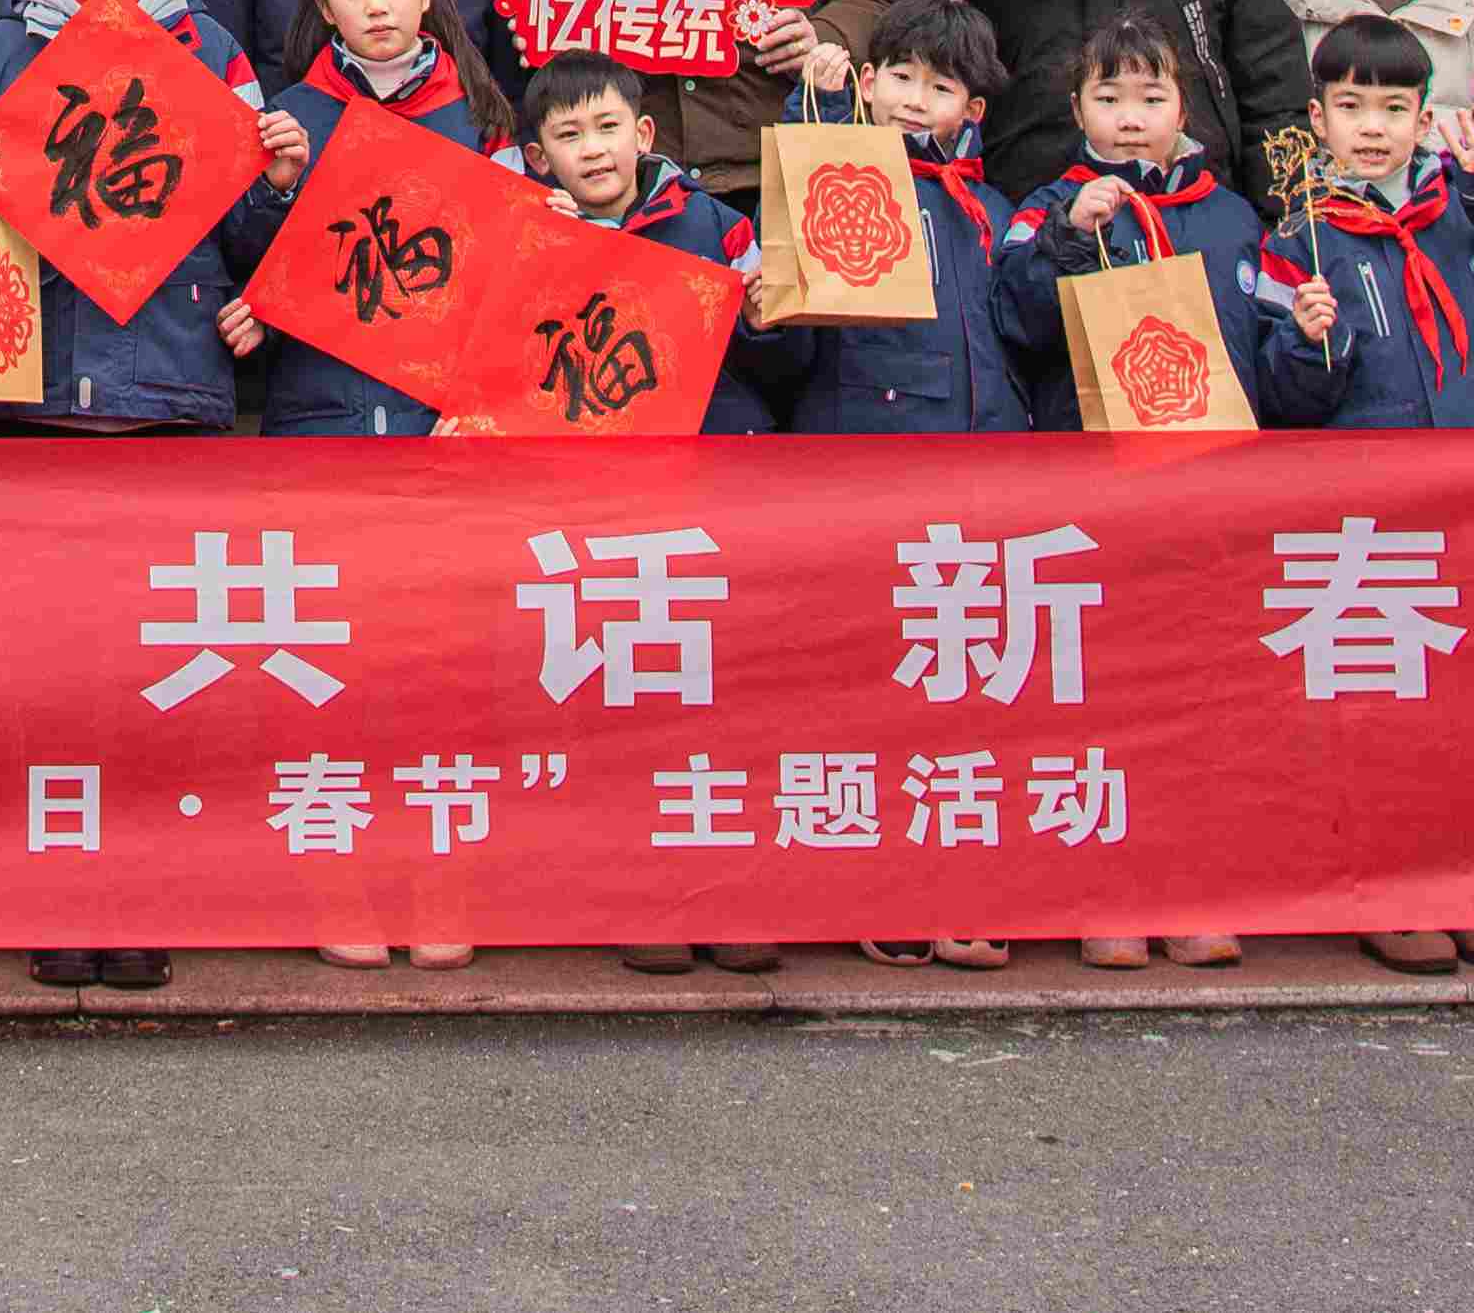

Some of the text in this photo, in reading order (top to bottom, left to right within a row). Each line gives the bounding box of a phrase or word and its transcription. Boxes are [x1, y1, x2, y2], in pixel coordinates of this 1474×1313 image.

[45, 77, 186, 230] 福
[325, 195, 452, 323] 福
[533, 292, 658, 423] 福
[139, 516, 1468, 712] 共话新春
